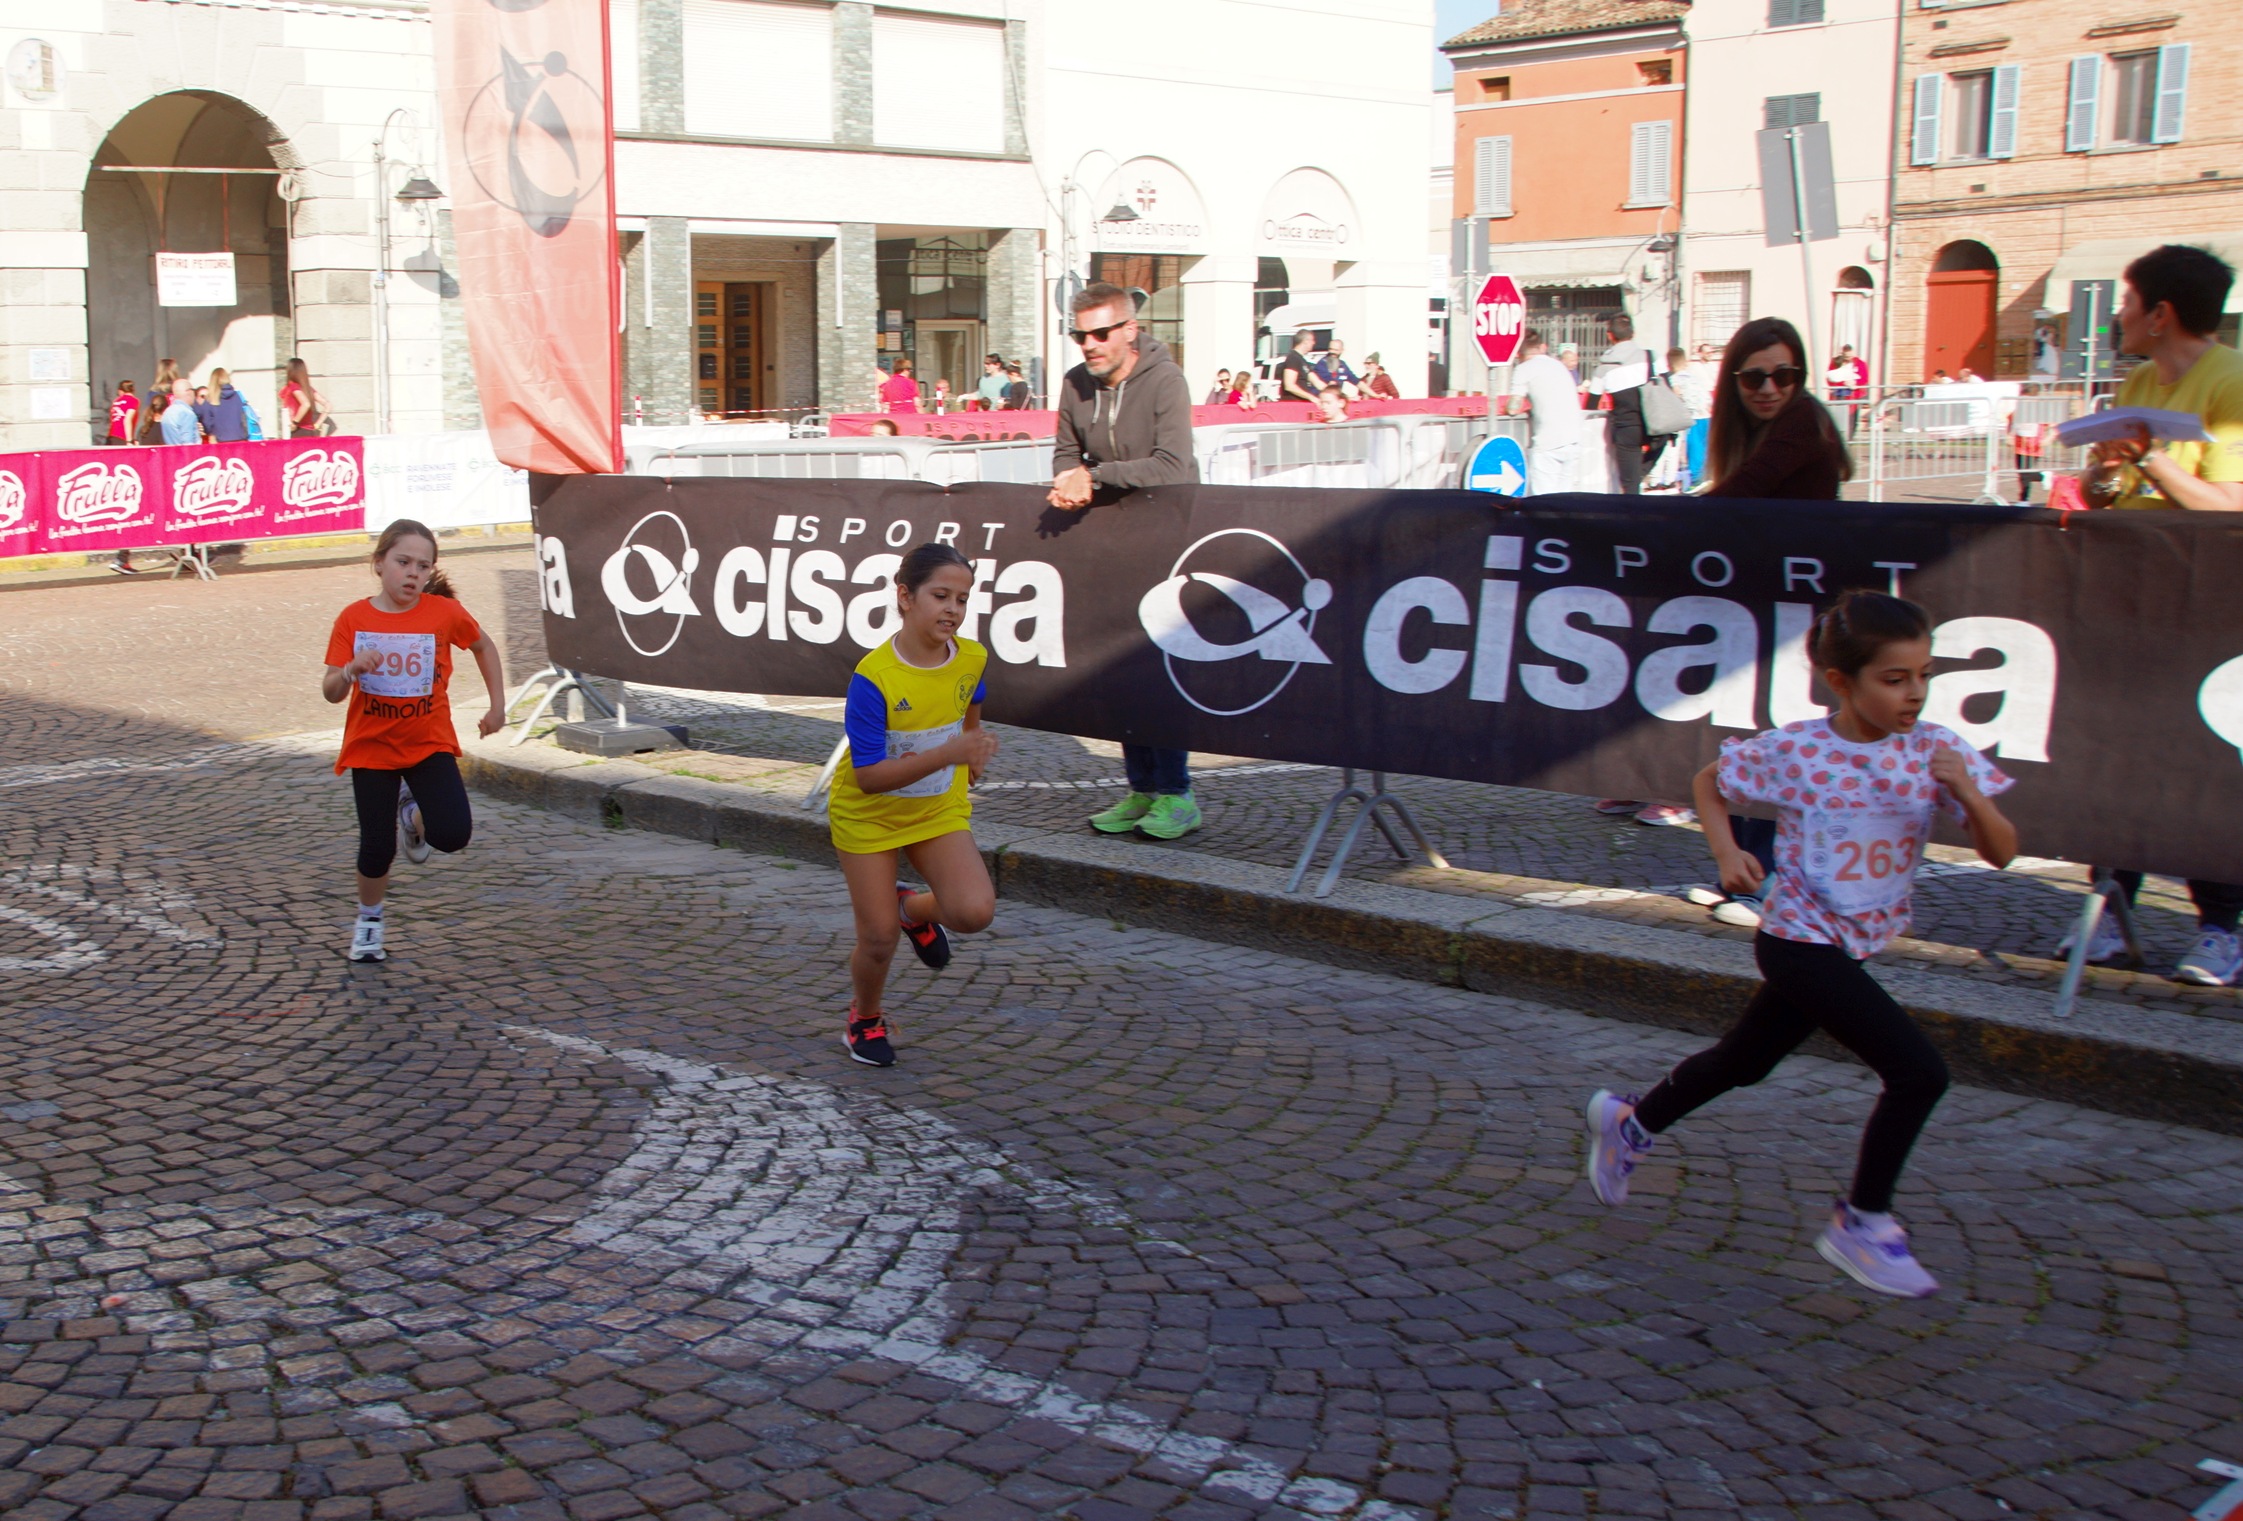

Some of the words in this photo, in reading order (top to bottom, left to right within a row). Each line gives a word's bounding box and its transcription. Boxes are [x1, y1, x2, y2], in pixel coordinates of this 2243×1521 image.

[1092, 221, 1132, 235] STUDIO
[1136, 222, 1201, 237] DENTISTICO
[1476, 302, 1522, 336] STOP
[934, 421, 1008, 432] SPORT
[406, 462, 457, 473] RAVENNATE
[406, 473, 454, 483] FORLIVESE
[416, 483, 453, 493] IMOLESE
[797, 515, 1005, 550] SPORT
[1531, 537, 1917, 598] SPORT
[714, 515, 1065, 668] cisafa
[1363, 535, 2058, 763] cisala
[369, 652, 422, 677] 296
[364, 696, 434, 719] LAMONE
[1833, 836, 1917, 882] 263
